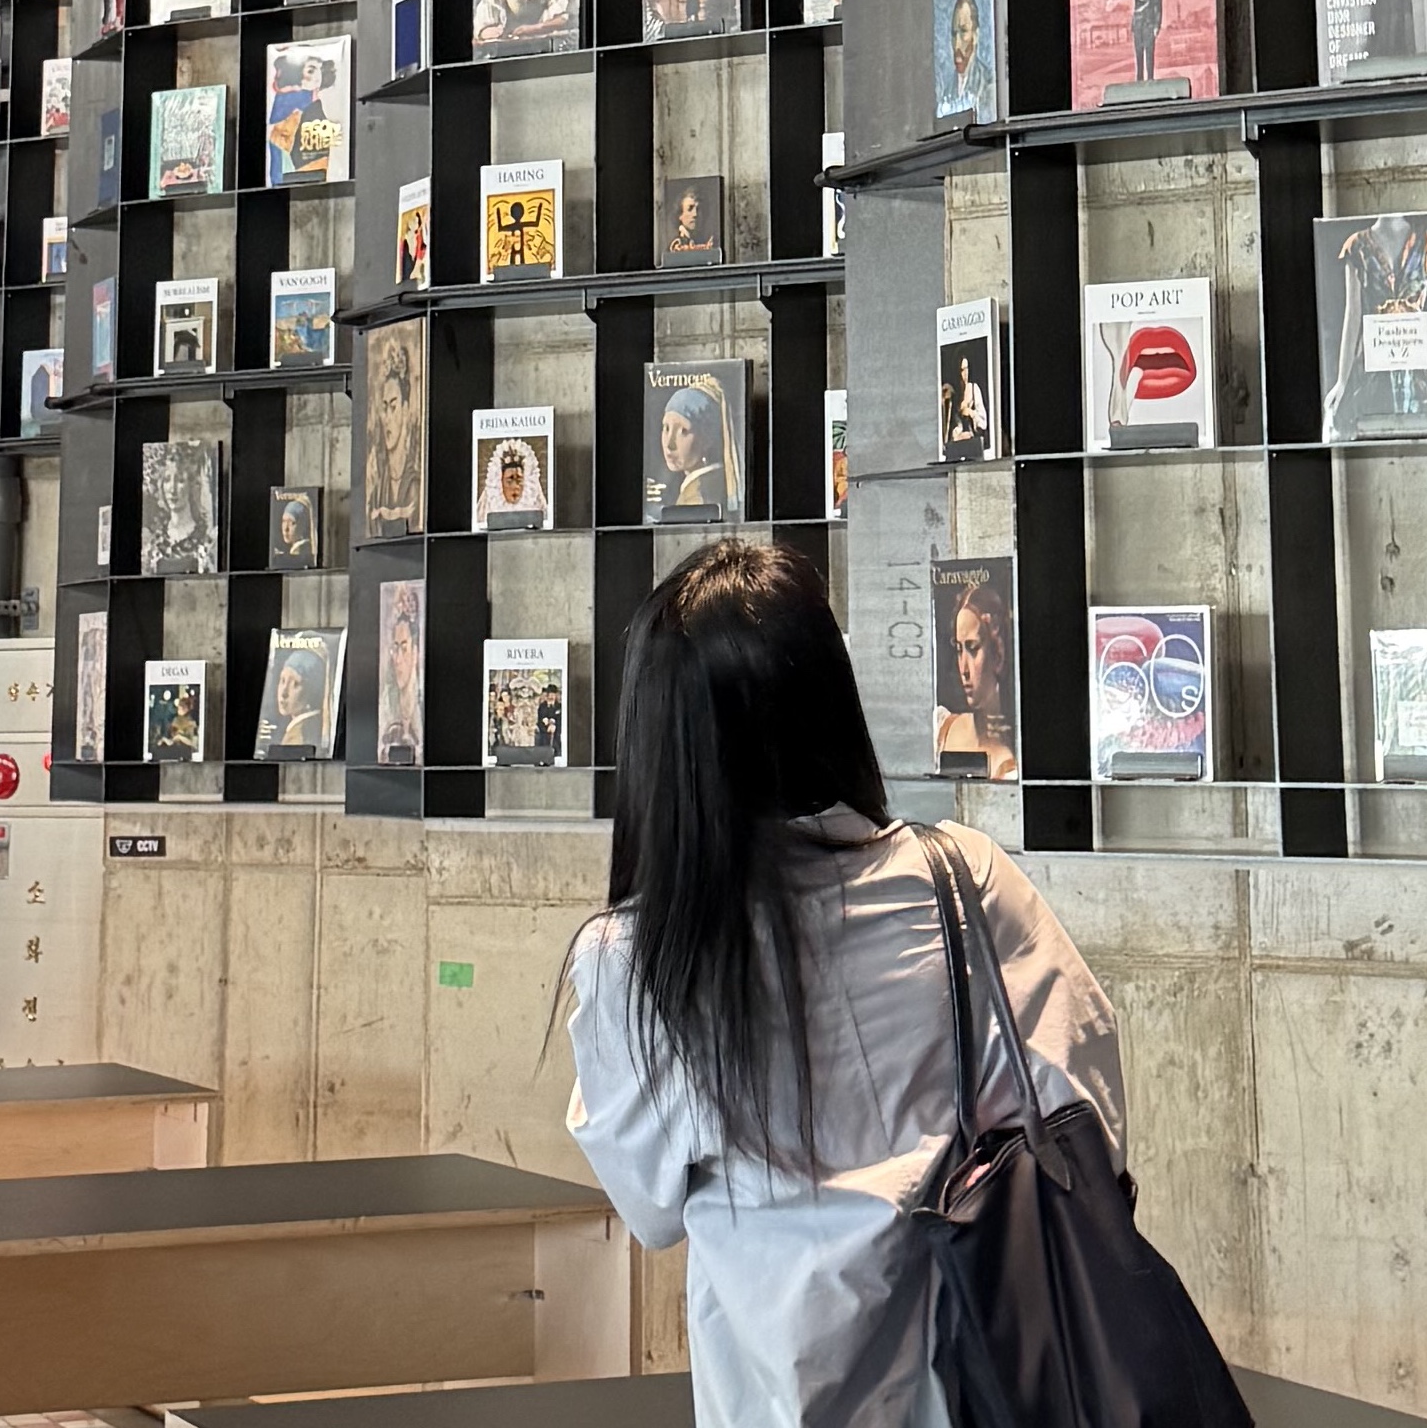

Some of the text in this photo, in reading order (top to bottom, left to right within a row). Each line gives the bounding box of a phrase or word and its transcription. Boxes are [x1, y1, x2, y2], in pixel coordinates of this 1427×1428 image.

[1327, 9, 1350, 25] DIOR
[1328, 21, 1375, 39] DESIGNER
[1329, 39, 1341, 54] OF
[498, 169, 545, 183] HARING
[299, 276, 327, 286] GOGH
[1111, 289, 1183, 309] POP ART
[1378, 326, 1417, 336] Fashion
[1373, 338, 1424, 349] Designers
[648, 370, 711, 388] Vermeer
[480, 416, 547, 430] FRIDA KAHLO
[932, 565, 990, 586] Caravaggio
[506, 648, 544, 660] RIVERA
